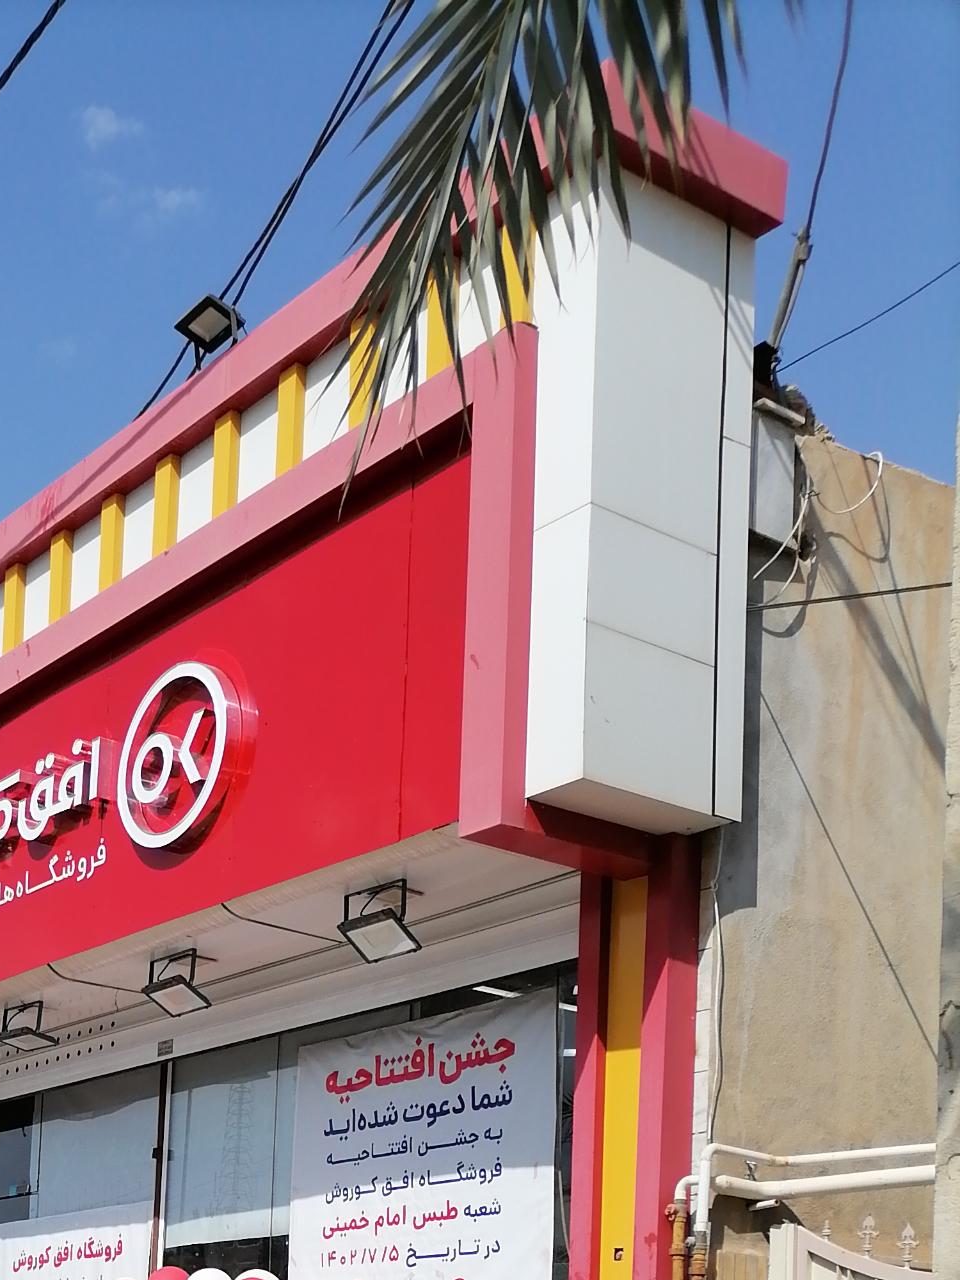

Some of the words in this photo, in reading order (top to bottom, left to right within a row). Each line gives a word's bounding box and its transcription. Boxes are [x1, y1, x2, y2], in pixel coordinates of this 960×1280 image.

[17, 736, 101, 841] افق
[325, 1036, 435, 1103] افتتاحیه
[439, 1032, 516, 1084] جشن
[471, 1080, 513, 1110] شما
[402, 1093, 465, 1127] دعوت
[417, 1130, 479, 1156] جشن
[483, 1126, 504, 1144] به
[326, 1135, 413, 1166] افتتاحیه
[381, 1172, 414, 1196] افق
[419, 1156, 502, 1187] فروشگاه
[325, 1176, 378, 1204] کوروش
[322, 1210, 369, 1239] خمینی
[374, 1205, 407, 1236] امام
[412, 1200, 458, 1230] طبس
[463, 1199, 502, 1222] شعبه
[12, 1246, 51, 1272] کوروش
[53, 1240, 74, 1267] افق
[77, 1234, 123, 1262] فروشگاه
[406, 1239, 480, 1267] تاریخ
[485, 1238, 501, 1259] در
